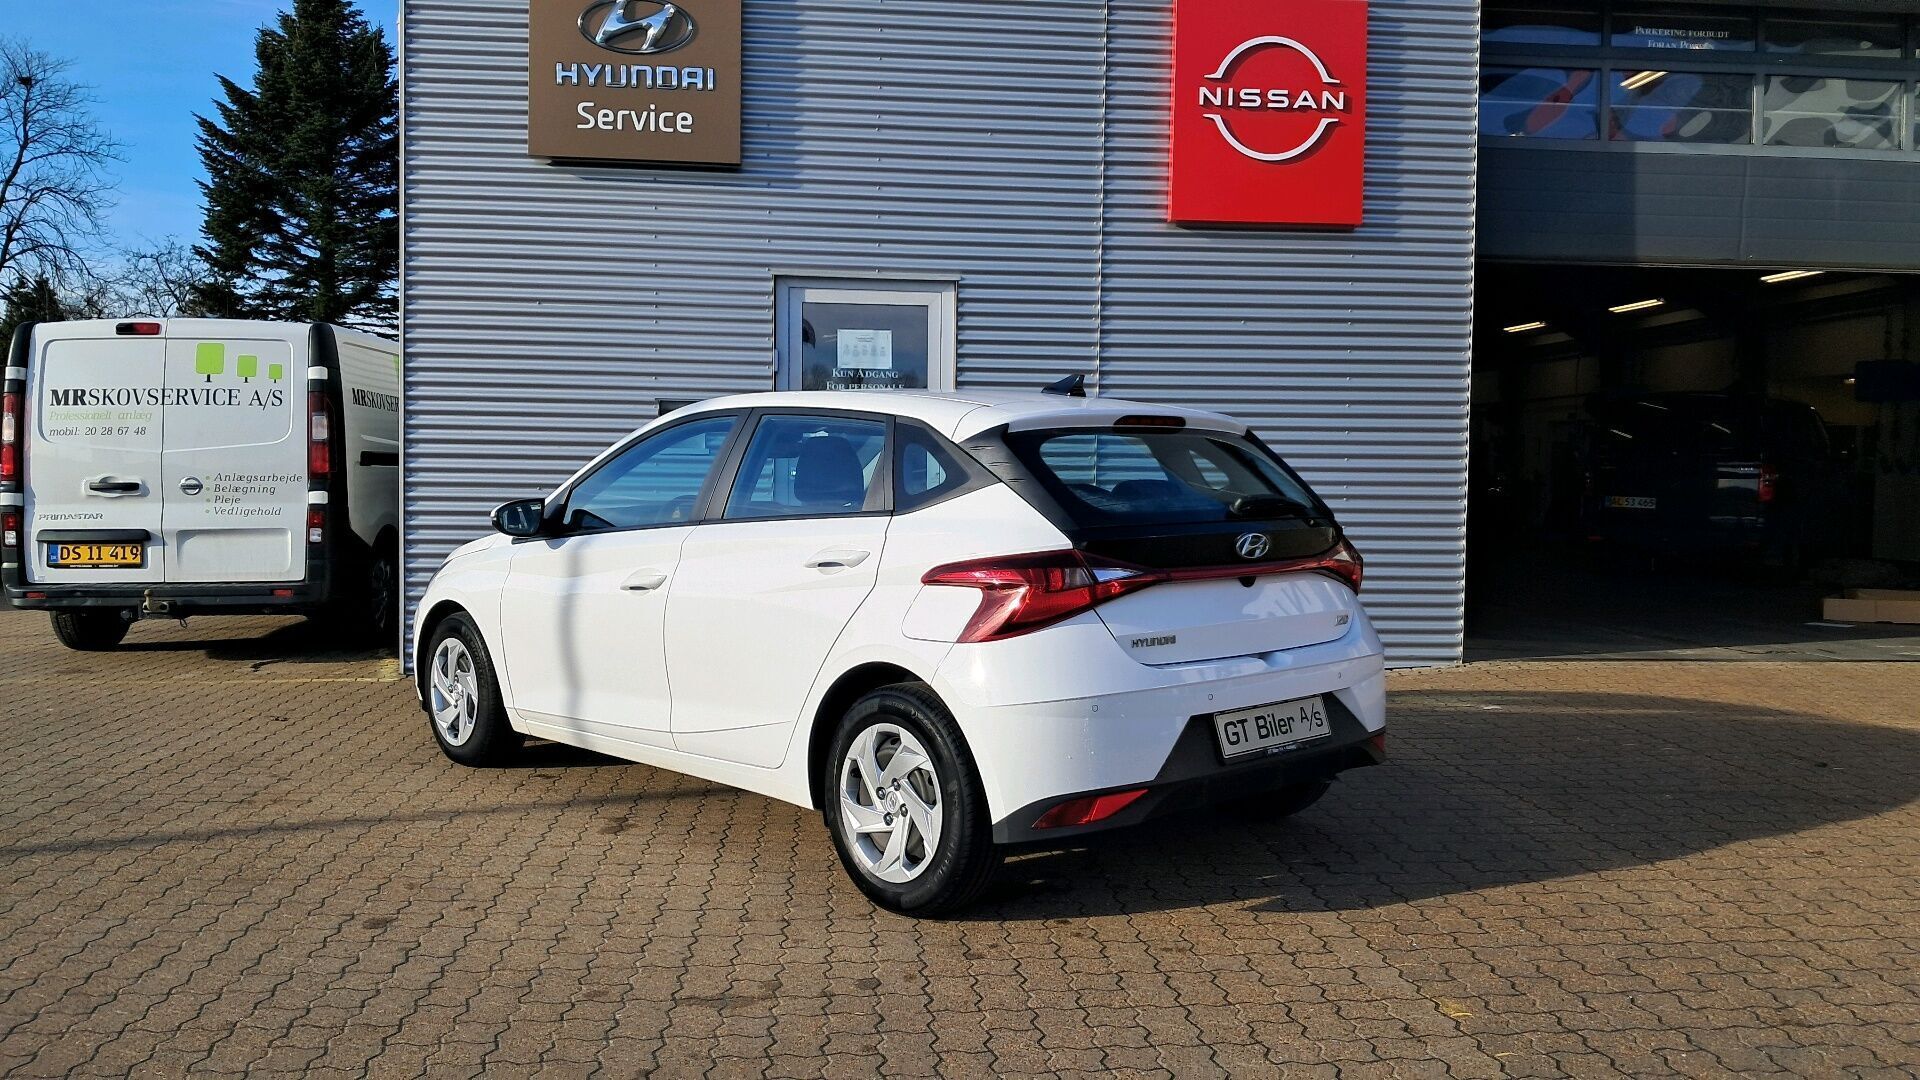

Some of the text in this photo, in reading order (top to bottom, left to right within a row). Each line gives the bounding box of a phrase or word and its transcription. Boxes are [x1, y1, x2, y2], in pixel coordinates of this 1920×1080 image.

[1635, 25, 1730, 38] PARKERING FORBUDT
[555, 62, 715, 91] HYUNDAI
[1198, 86, 1345, 110] NISSAN
[576, 101, 694, 134] Service
[856, 368, 899, 379] ADGANG
[50, 387, 284, 411] MRSKOVSERVICE A/S
[118, 410, 153, 422] anlæg
[49, 426, 147, 437] mobil: 20 28 67 48
[214, 472, 303, 484] Anlægsarbejde
[214, 483, 276, 495] Belægning
[214, 494, 241, 506] Pleje
[38, 512, 104, 521] PRIMASTAR
[214, 506, 282, 518] Vedligehold
[60, 546, 140, 561] DS 11 419
[1131, 635, 1177, 649] HYUNDAI
[1222, 718, 1250, 747] GT
[1254, 713, 1295, 741] Biler
